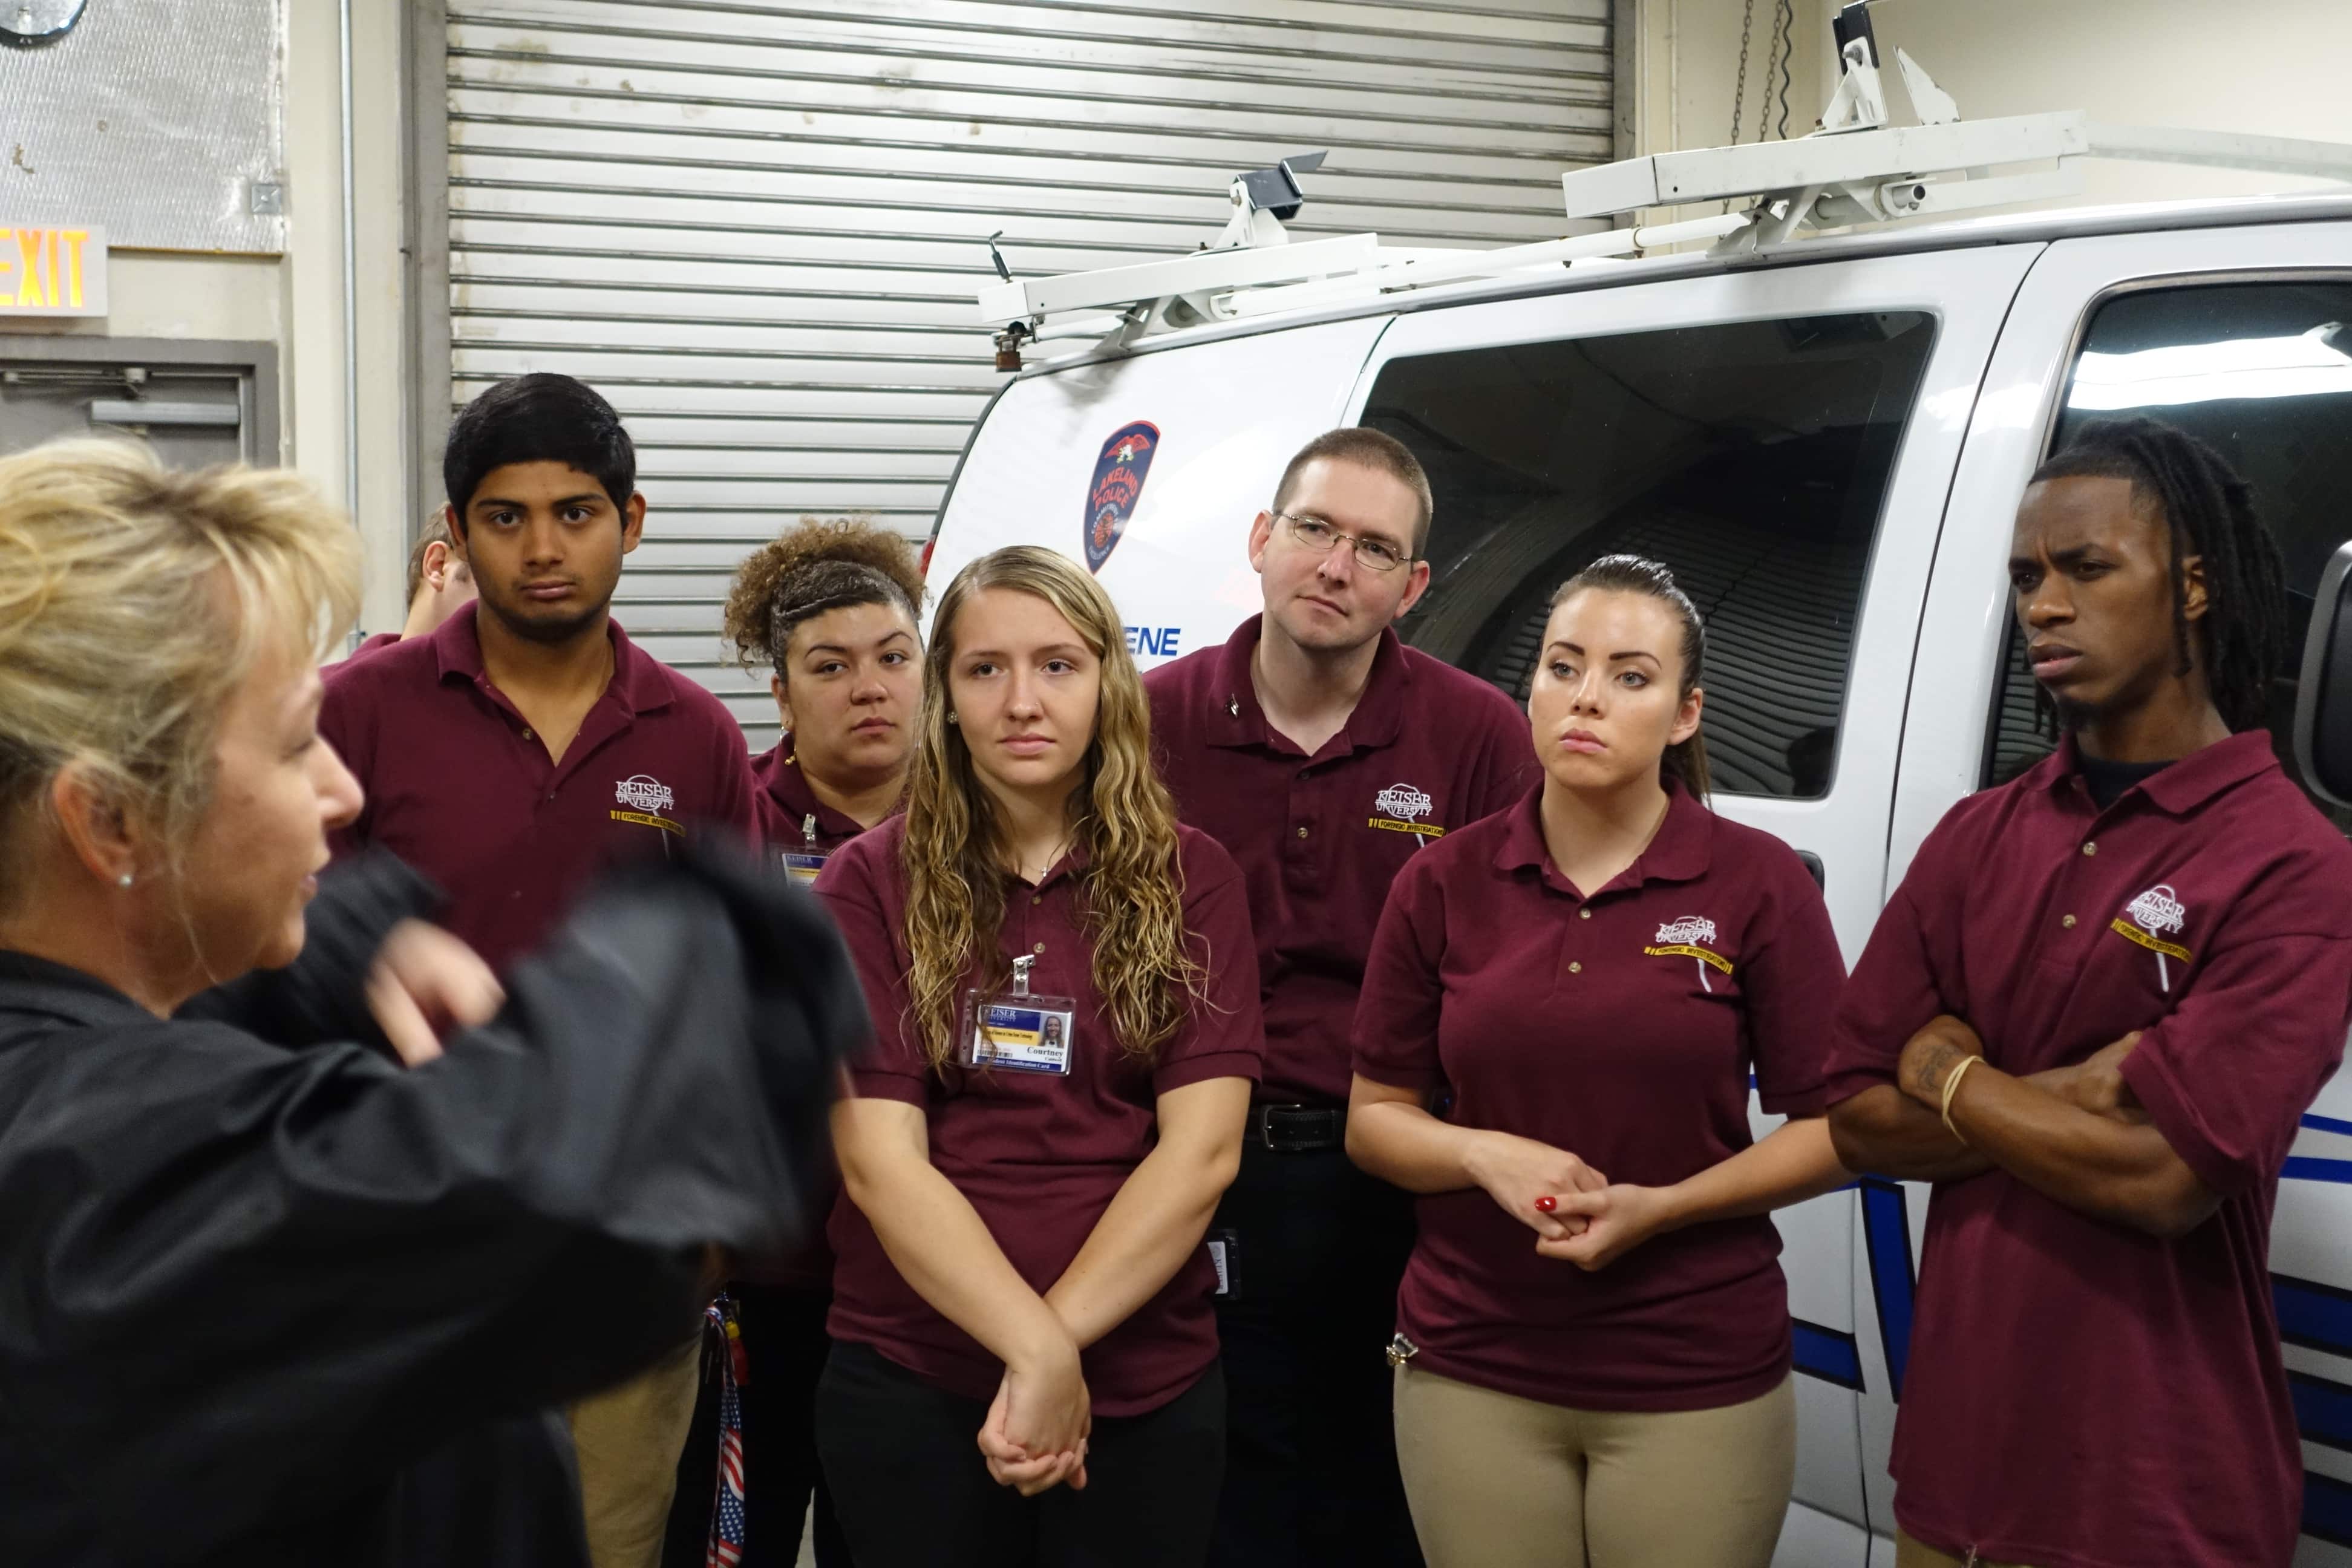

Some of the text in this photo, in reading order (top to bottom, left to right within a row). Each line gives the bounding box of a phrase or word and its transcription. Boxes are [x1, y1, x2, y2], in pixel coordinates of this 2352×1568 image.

[0, 229, 88, 307] EXIT
[1093, 466, 1138, 501] LAKELAND
[1095, 486, 1129, 511] POLICE
[615, 780, 673, 799] KEISER
[1376, 790, 1432, 806] KEISER
[1380, 821, 1405, 831] FORENSIC
[1659, 920, 1716, 936] KEISER
[984, 1007, 1016, 1018] EISER
[1027, 1047, 1063, 1057] Courtney
